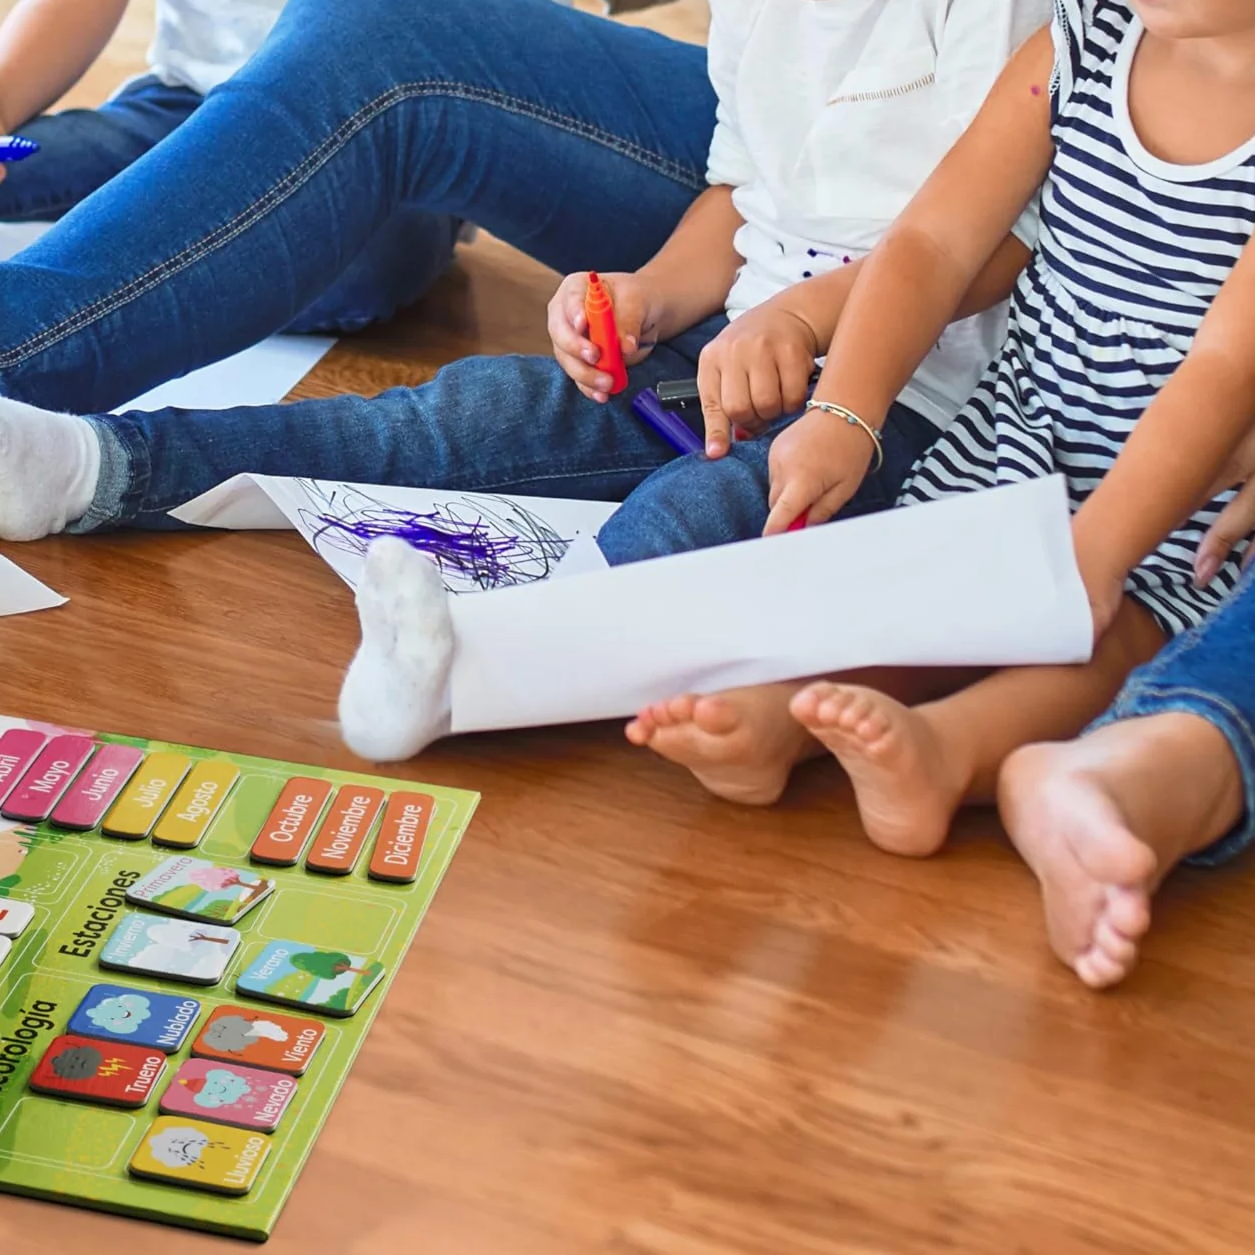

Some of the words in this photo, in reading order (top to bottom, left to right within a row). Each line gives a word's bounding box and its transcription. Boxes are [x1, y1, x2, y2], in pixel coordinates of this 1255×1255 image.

[29, 760, 70, 794] Mayo
[81, 767, 119, 802] Junio
[133, 778, 167, 808] Julio
[176, 781, 219, 822] Agosto
[269, 794, 313, 843] Octubre
[320, 795, 371, 860] Noviembre
[384, 804, 423, 865] Diciembre
[133, 857, 193, 898] Primavera
[59, 870, 141, 958] Estaciones
[112, 919, 145, 957] Invierno
[249, 947, 290, 981] Verano
[156, 1000, 198, 1046] Nublado
[281, 1028, 318, 1063] Viento
[124, 1056, 161, 1093] Trueno
[253, 1079, 293, 1123] Nevado
[223, 1136, 265, 1184] Lluvioso
